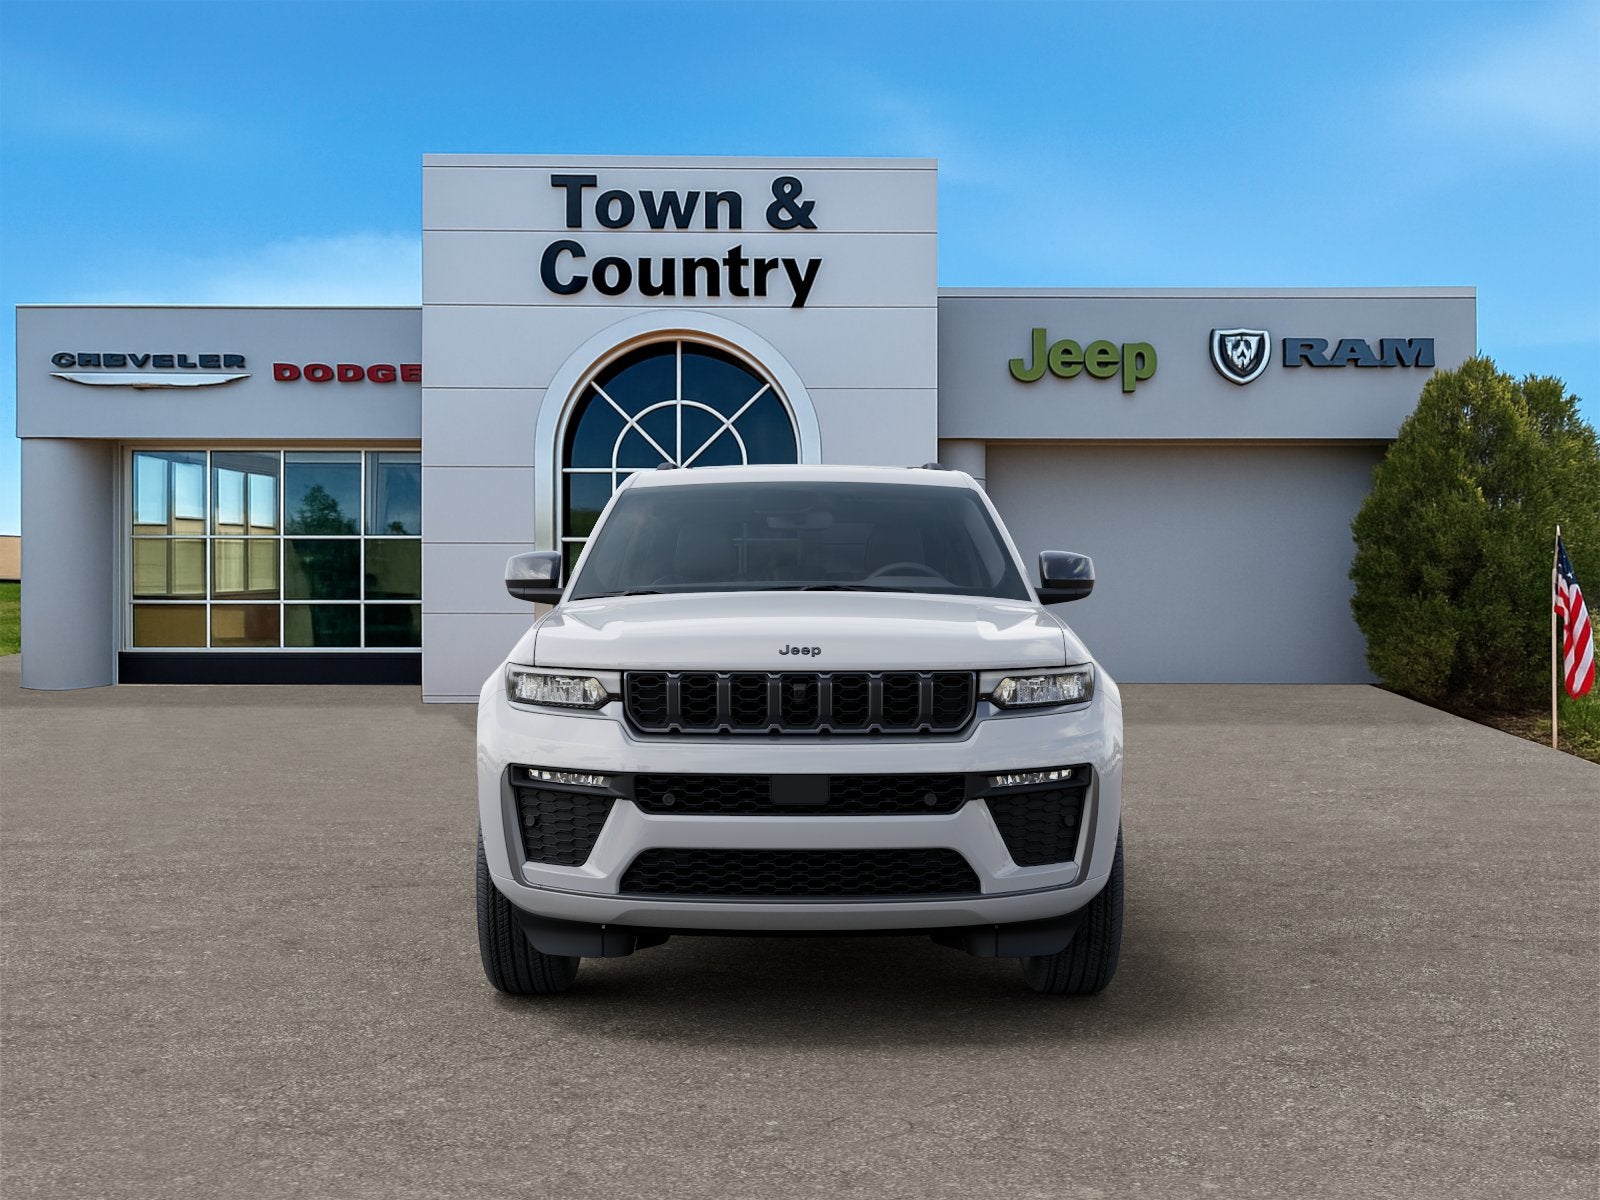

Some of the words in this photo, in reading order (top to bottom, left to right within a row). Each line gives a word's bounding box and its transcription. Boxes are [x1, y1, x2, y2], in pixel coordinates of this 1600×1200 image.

[550, 174, 743, 230] Town
[765, 175, 818, 230] &
[539, 239, 823, 308] Country
[273, 363, 422, 383] DODGE
[1008, 327, 1158, 393] Jeep
[1282, 337, 1436, 368] RAM
[779, 644, 822, 657] Jeep
